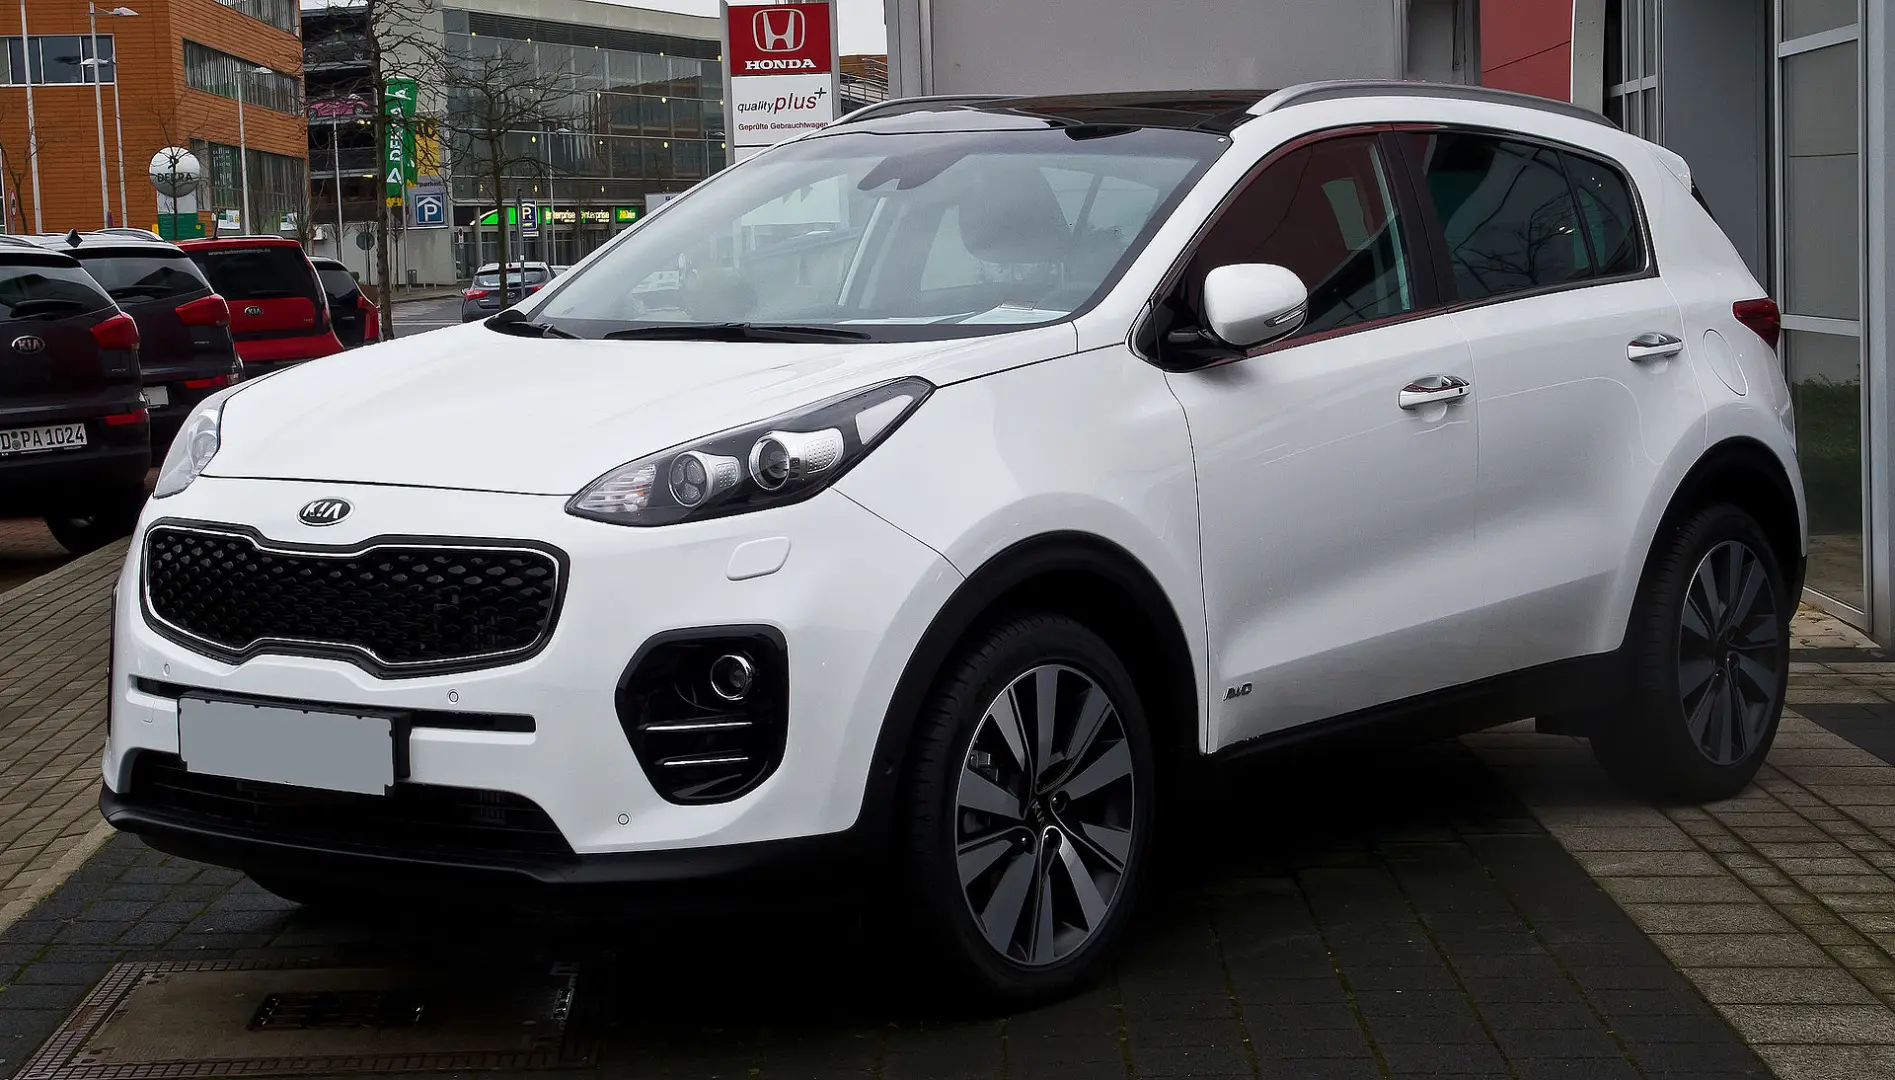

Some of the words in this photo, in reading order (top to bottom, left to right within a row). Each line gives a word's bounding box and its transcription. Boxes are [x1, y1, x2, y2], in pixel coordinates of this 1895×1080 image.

[745, 59, 816, 69] HONDA
[738, 123, 768, 131] Geprüfte
[770, 121, 828, 130] Gebrauchtwagen
[248, 307, 262, 315] KIA
[18, 339, 41, 350] KIA
[0, 432, 11, 450] D
[20, 430, 43, 448] PA
[45, 425, 85, 446] 1024
[303, 501, 343, 519] KIA
